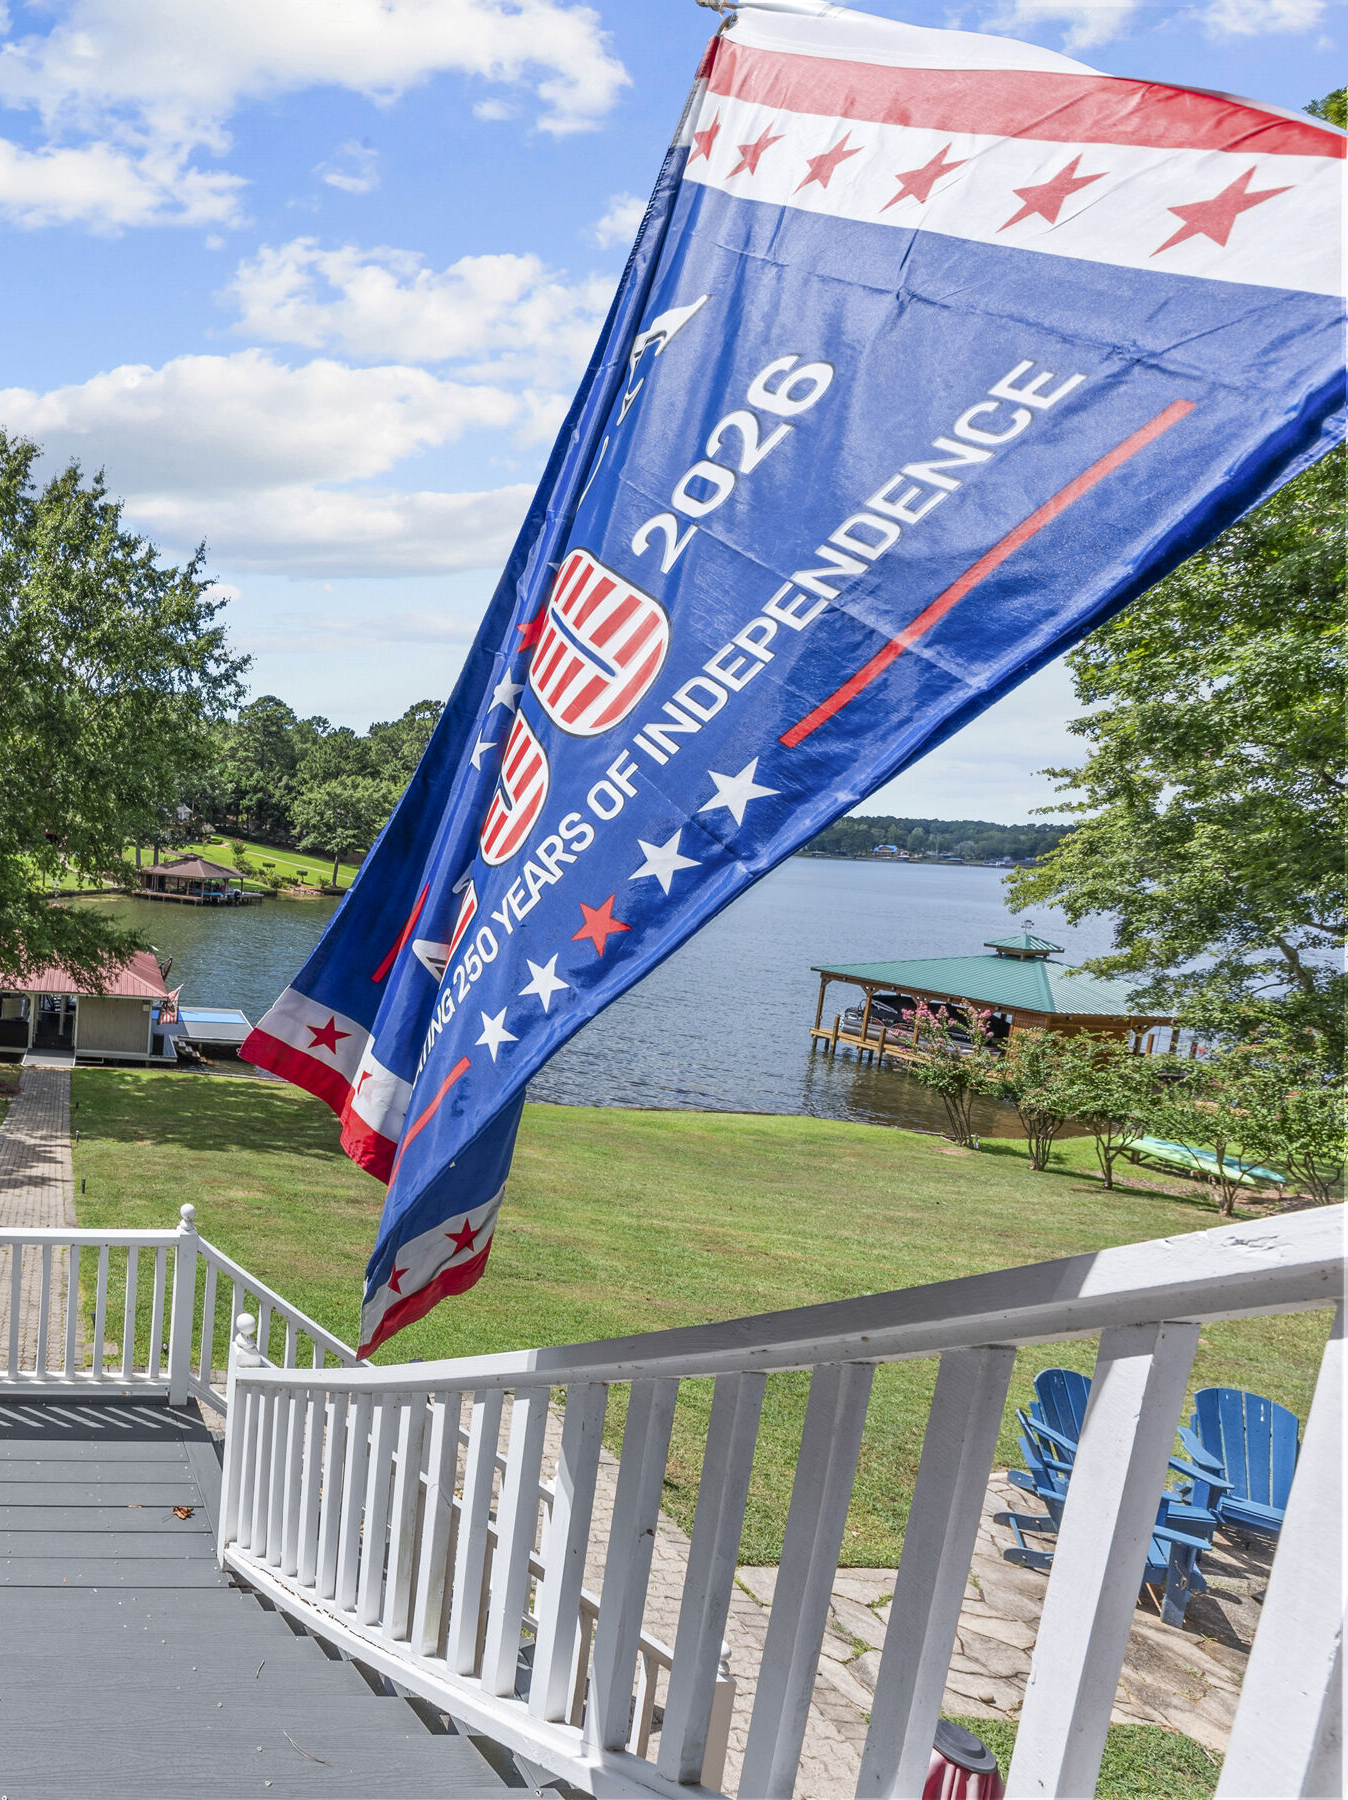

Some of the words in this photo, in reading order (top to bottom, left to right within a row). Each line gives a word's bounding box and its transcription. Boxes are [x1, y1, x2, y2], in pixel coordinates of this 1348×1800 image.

[453, 925, 499, 1004] 250
[490, 811, 595, 936] YEARS
[586, 748, 640, 821] OF
[632, 359, 1089, 766] INDEPENDENCE
[630, 353, 837, 576] 2026
